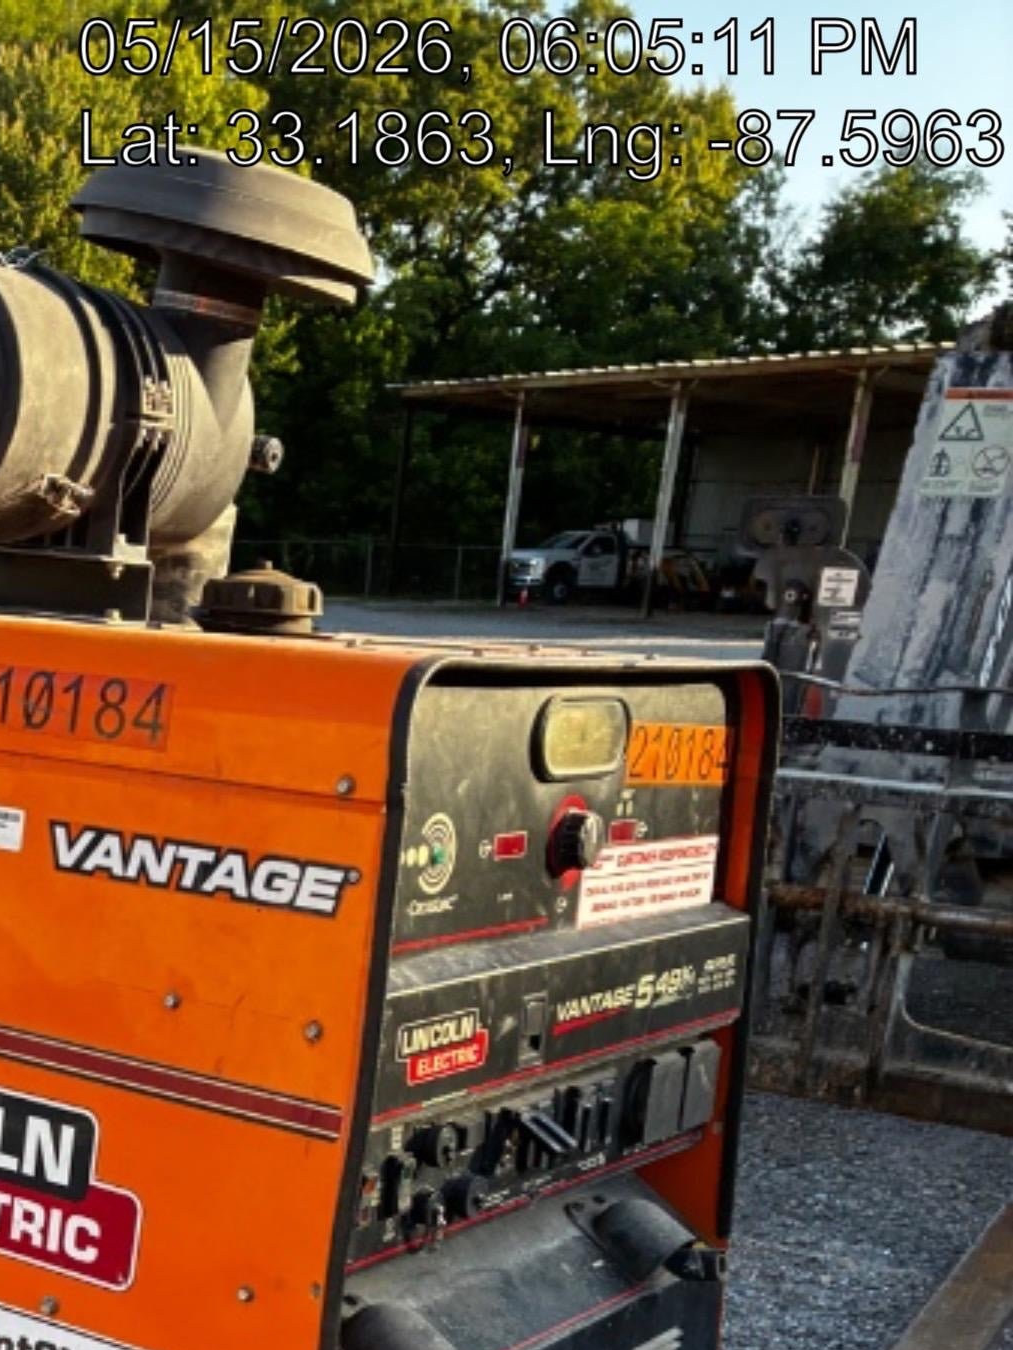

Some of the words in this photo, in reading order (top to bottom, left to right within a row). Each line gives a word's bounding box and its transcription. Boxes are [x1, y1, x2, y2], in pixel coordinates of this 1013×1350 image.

[51, 822, 346, 915] VANTAGE
[401, 1014, 475, 1056] LINCOLN
[416, 1043, 479, 1078] ELECTRIC
